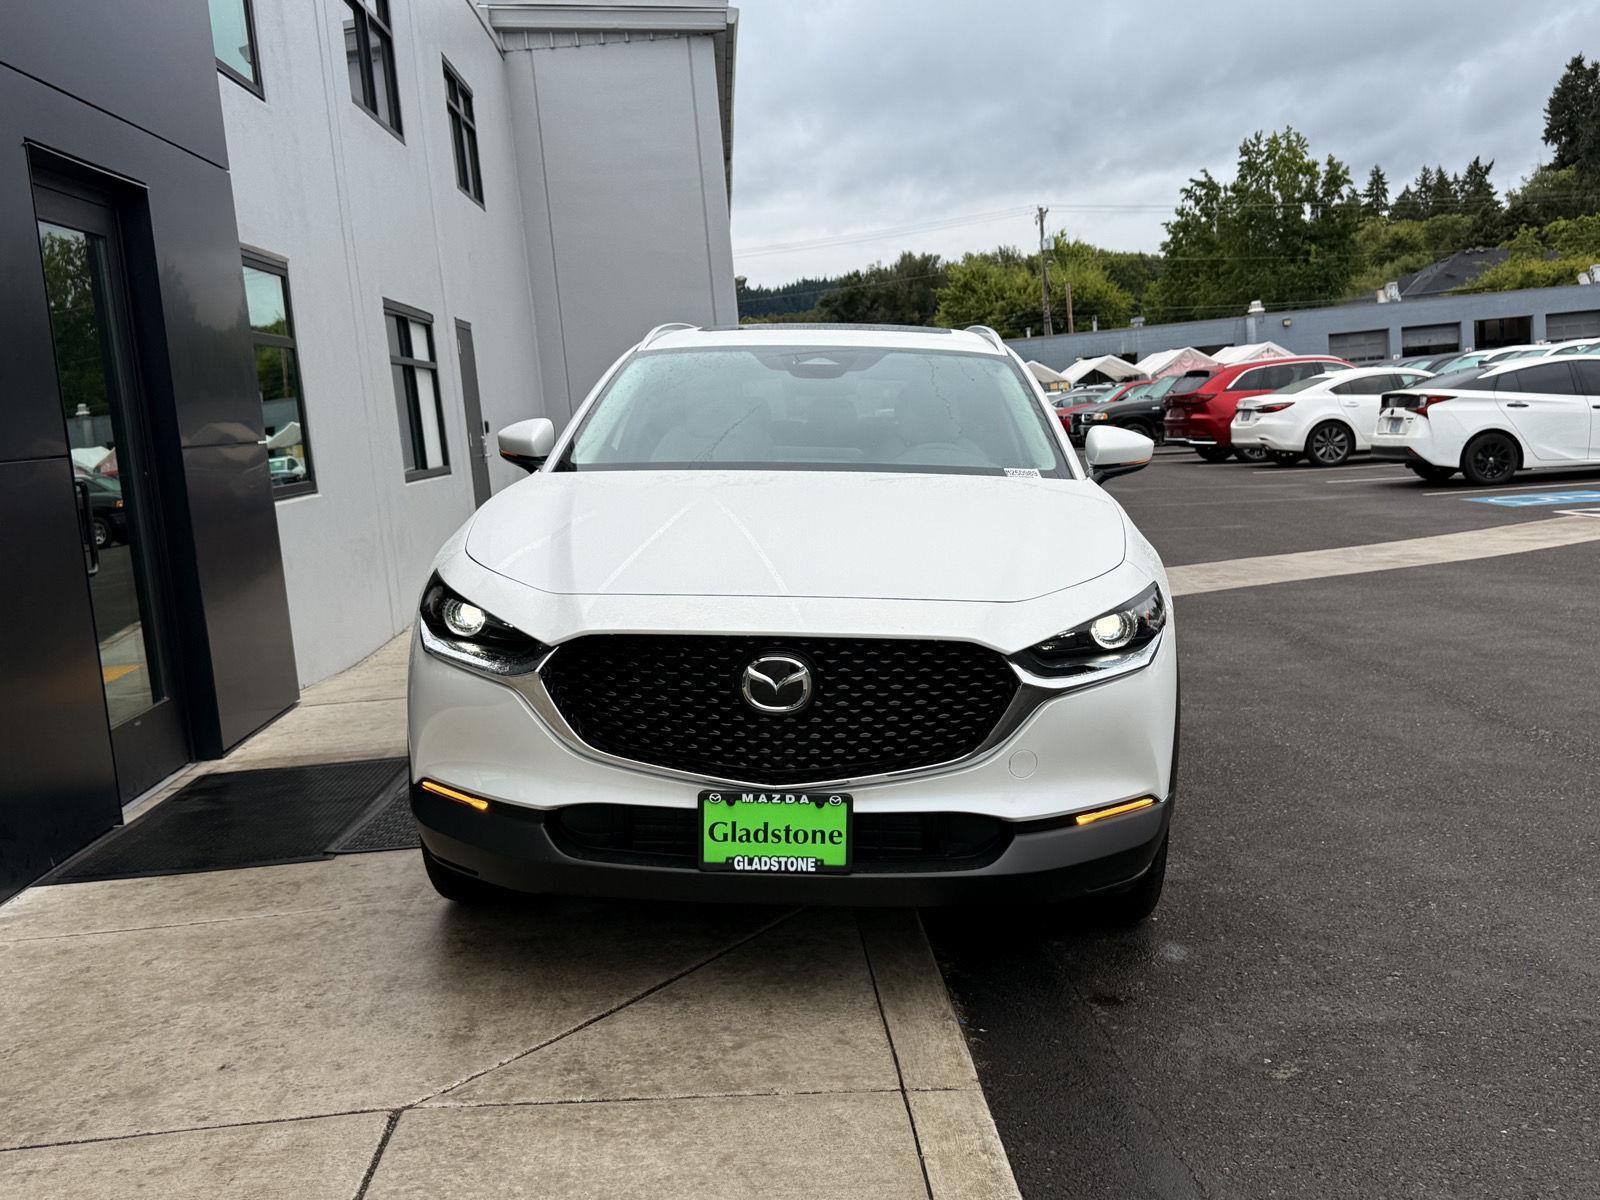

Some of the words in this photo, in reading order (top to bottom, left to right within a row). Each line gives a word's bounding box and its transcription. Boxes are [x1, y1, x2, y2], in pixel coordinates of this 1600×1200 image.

[742, 793, 810, 804] MAZDA
[708, 821, 843, 845] Gladstone
[734, 856, 816, 872] GLADSTONE
